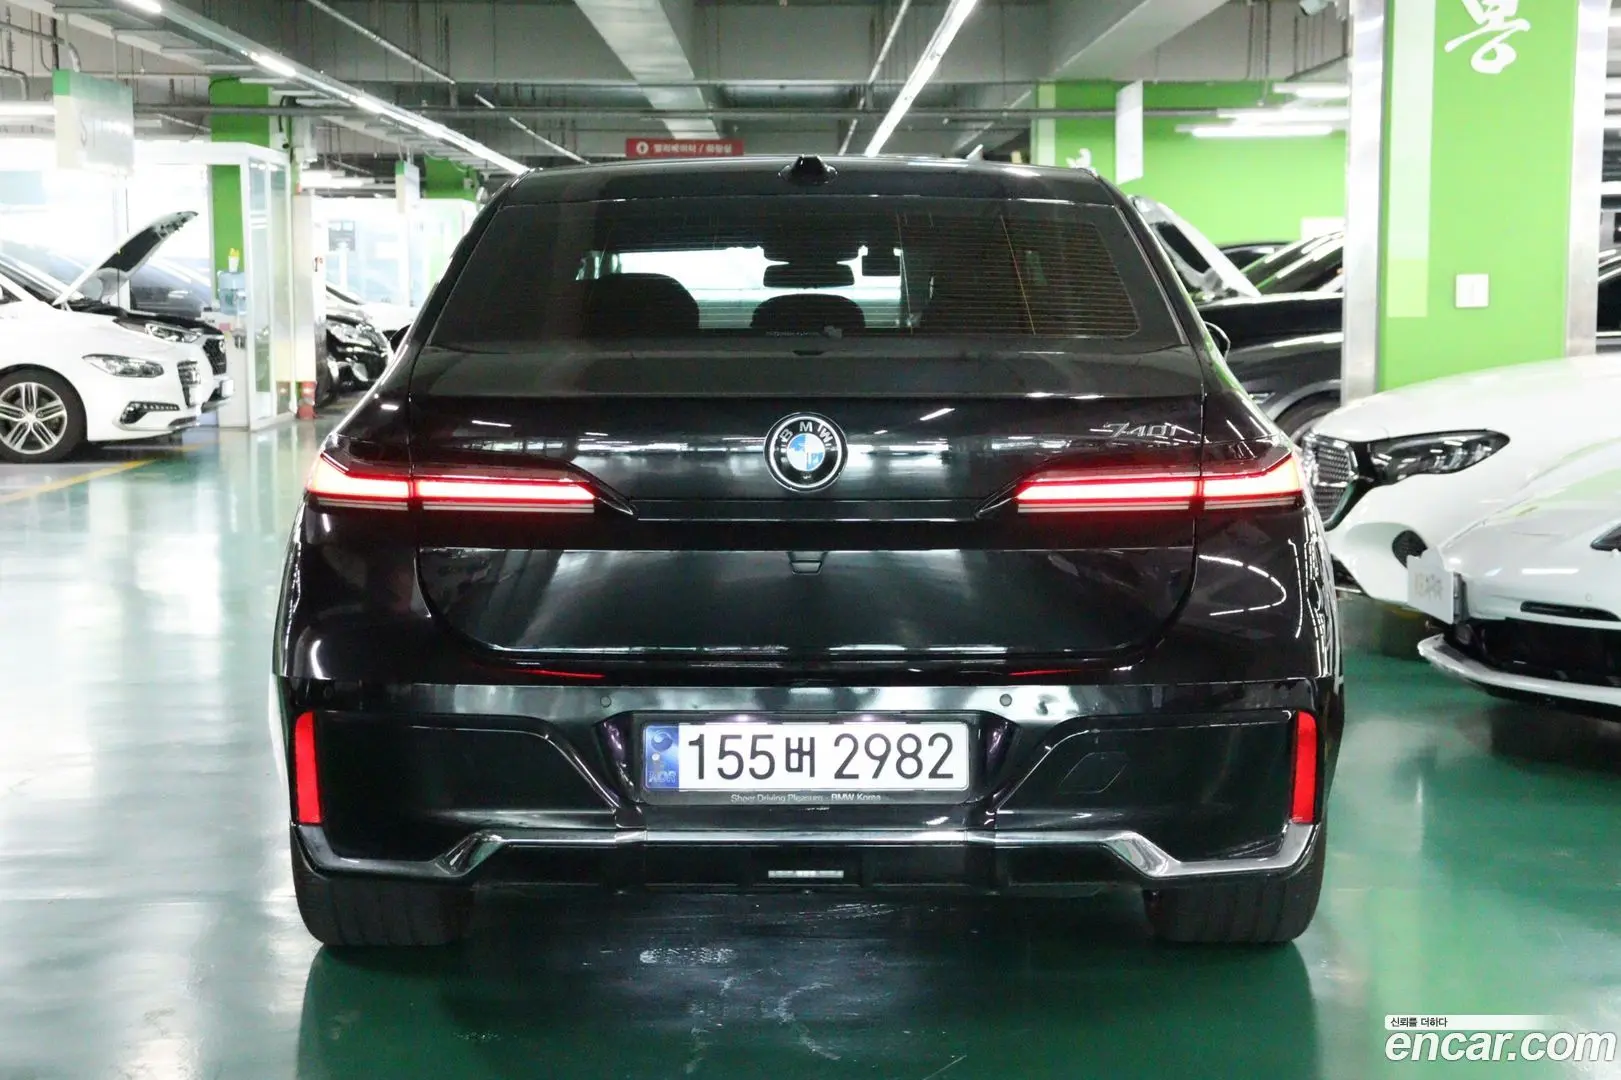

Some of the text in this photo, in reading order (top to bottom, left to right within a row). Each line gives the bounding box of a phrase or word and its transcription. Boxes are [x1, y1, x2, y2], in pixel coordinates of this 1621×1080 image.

[653, 143, 697, 153] 엘리베이터
[780, 421, 833, 443] BMW
[688, 732, 954, 780] 155버 2982
[730, 793, 882, 804] Sheer Driving Pleasure BMW Korea
